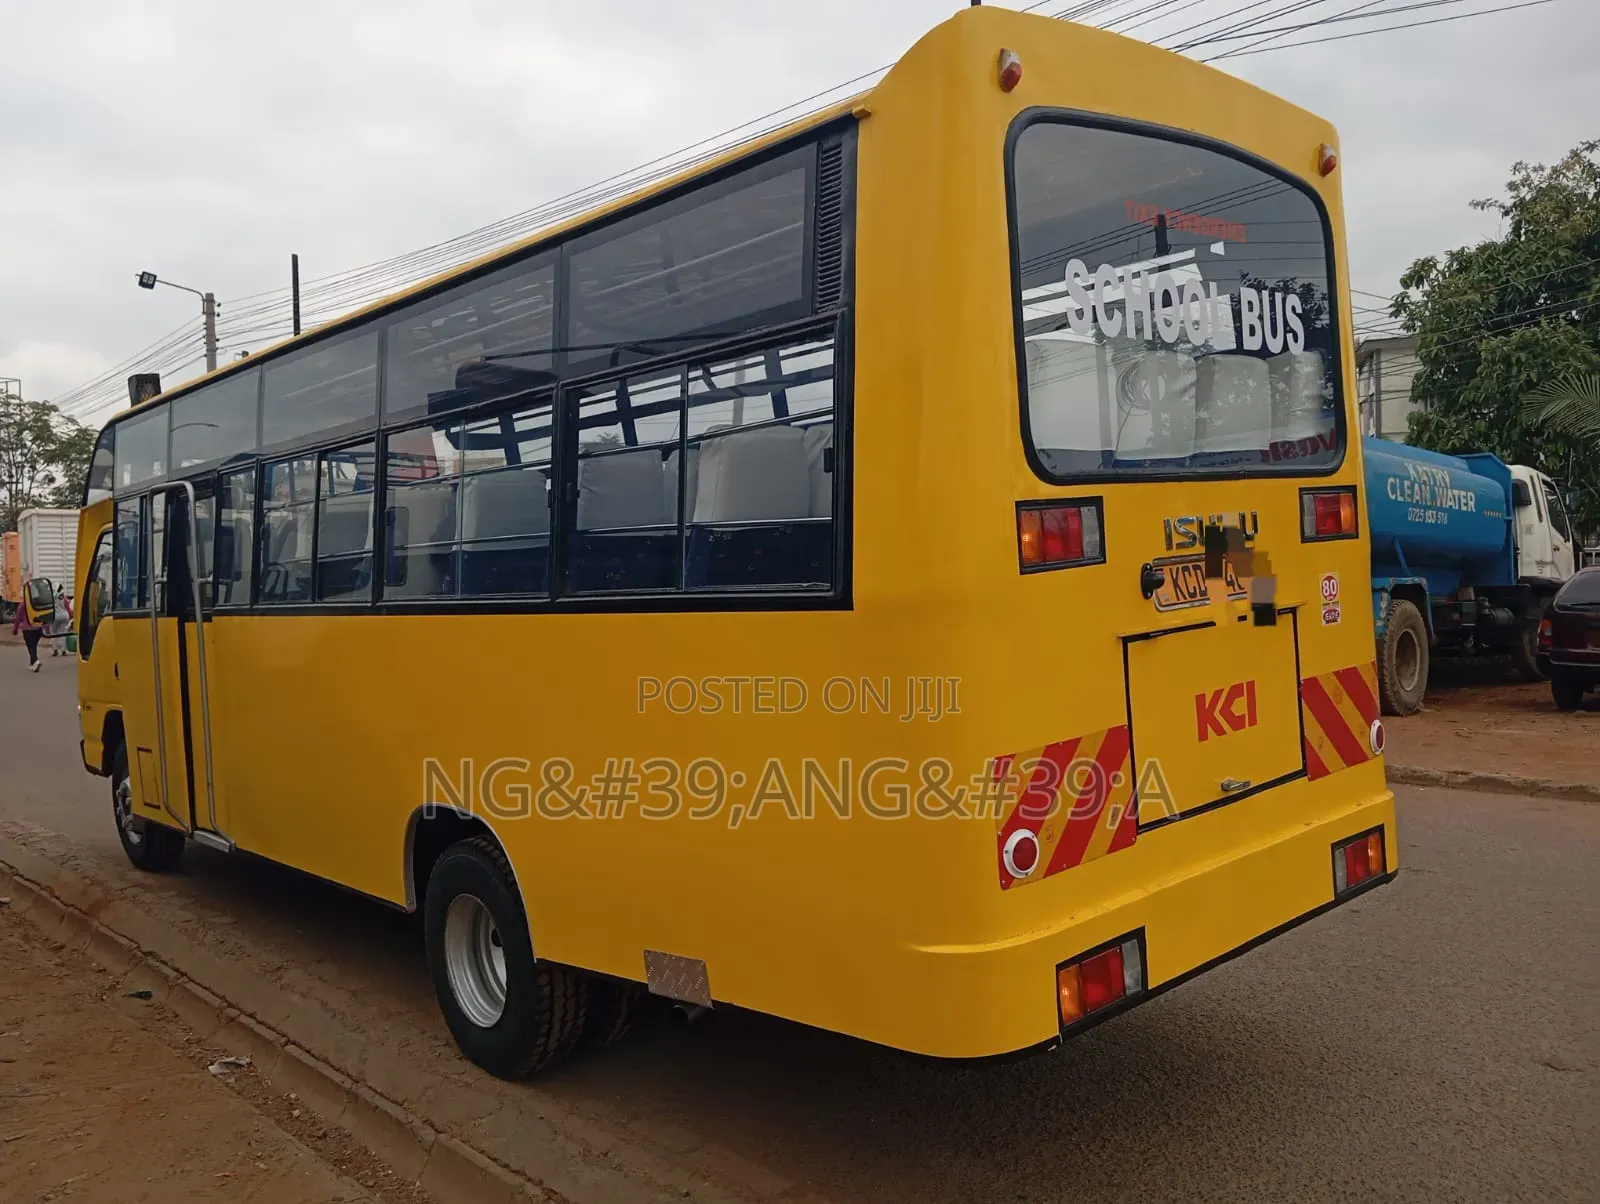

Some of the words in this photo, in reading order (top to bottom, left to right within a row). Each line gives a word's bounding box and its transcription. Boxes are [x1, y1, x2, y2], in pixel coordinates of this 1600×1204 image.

[1064, 258, 1236, 350] SCHOOL
[1239, 287, 1305, 355] BUS
[1436, 486, 1476, 512] WATER
[1163, 511, 1258, 550] ISUU
[1322, 579, 1337, 597] 80
[1195, 680, 1258, 742] KCI
